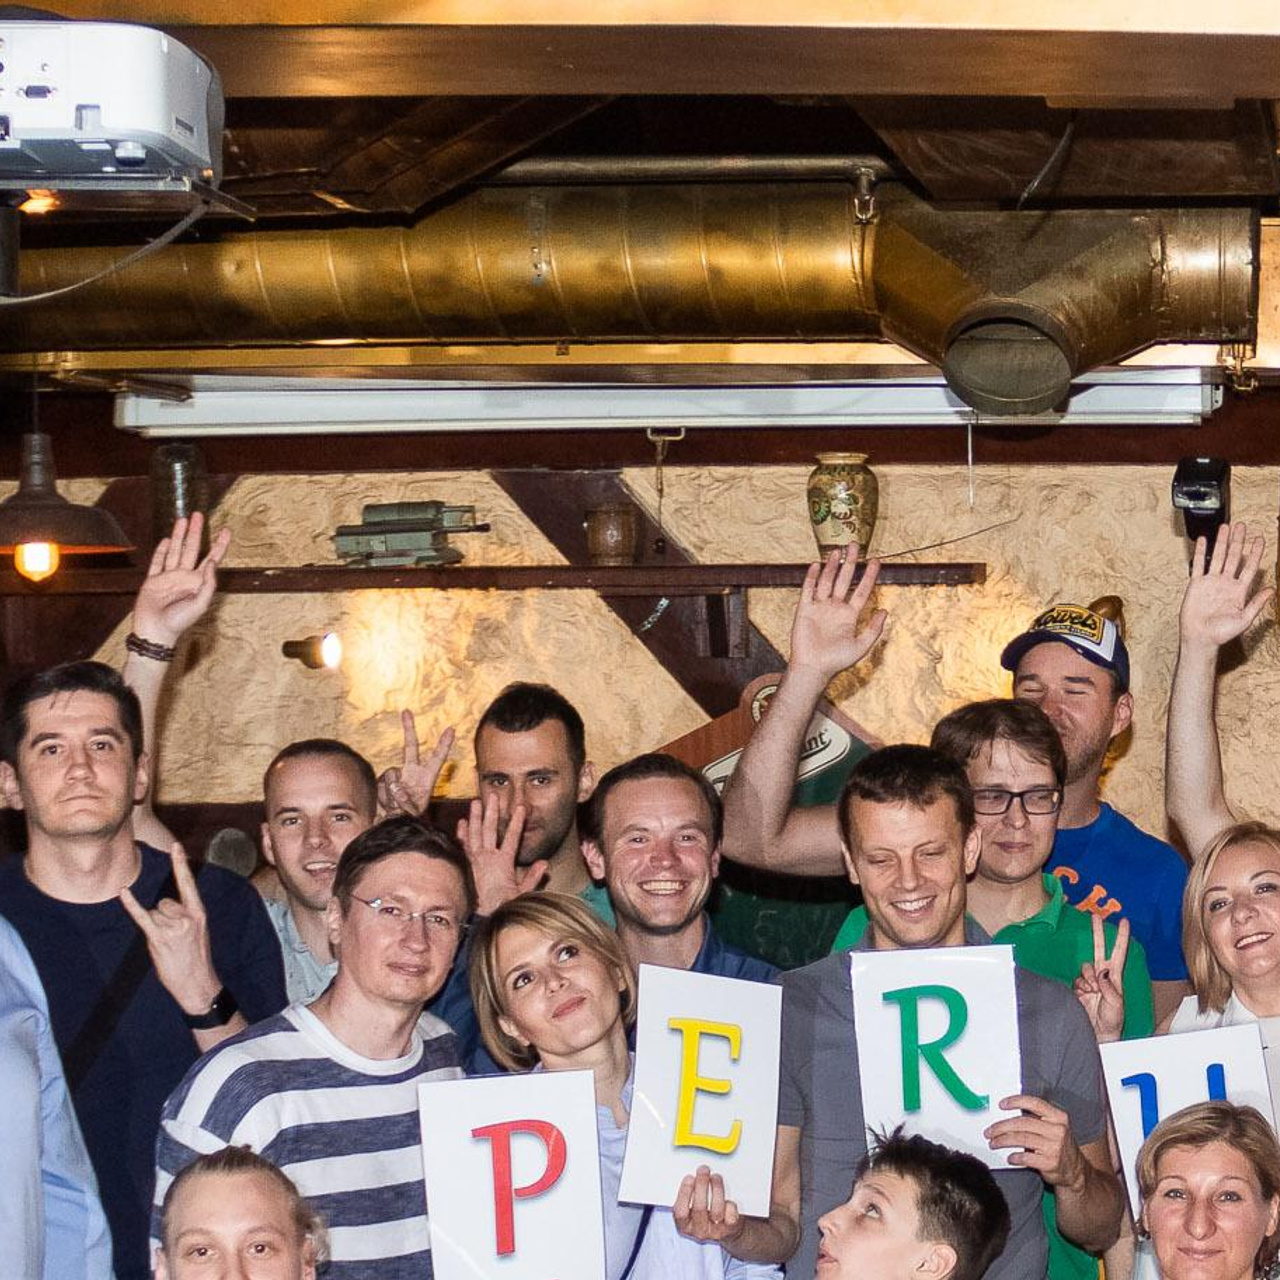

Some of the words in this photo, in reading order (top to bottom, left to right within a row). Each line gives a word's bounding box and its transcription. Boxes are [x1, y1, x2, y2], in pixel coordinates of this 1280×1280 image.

[669, 1018, 742, 1154] E
[883, 985, 989, 1113] R
[472, 1119, 567, 1255] P
